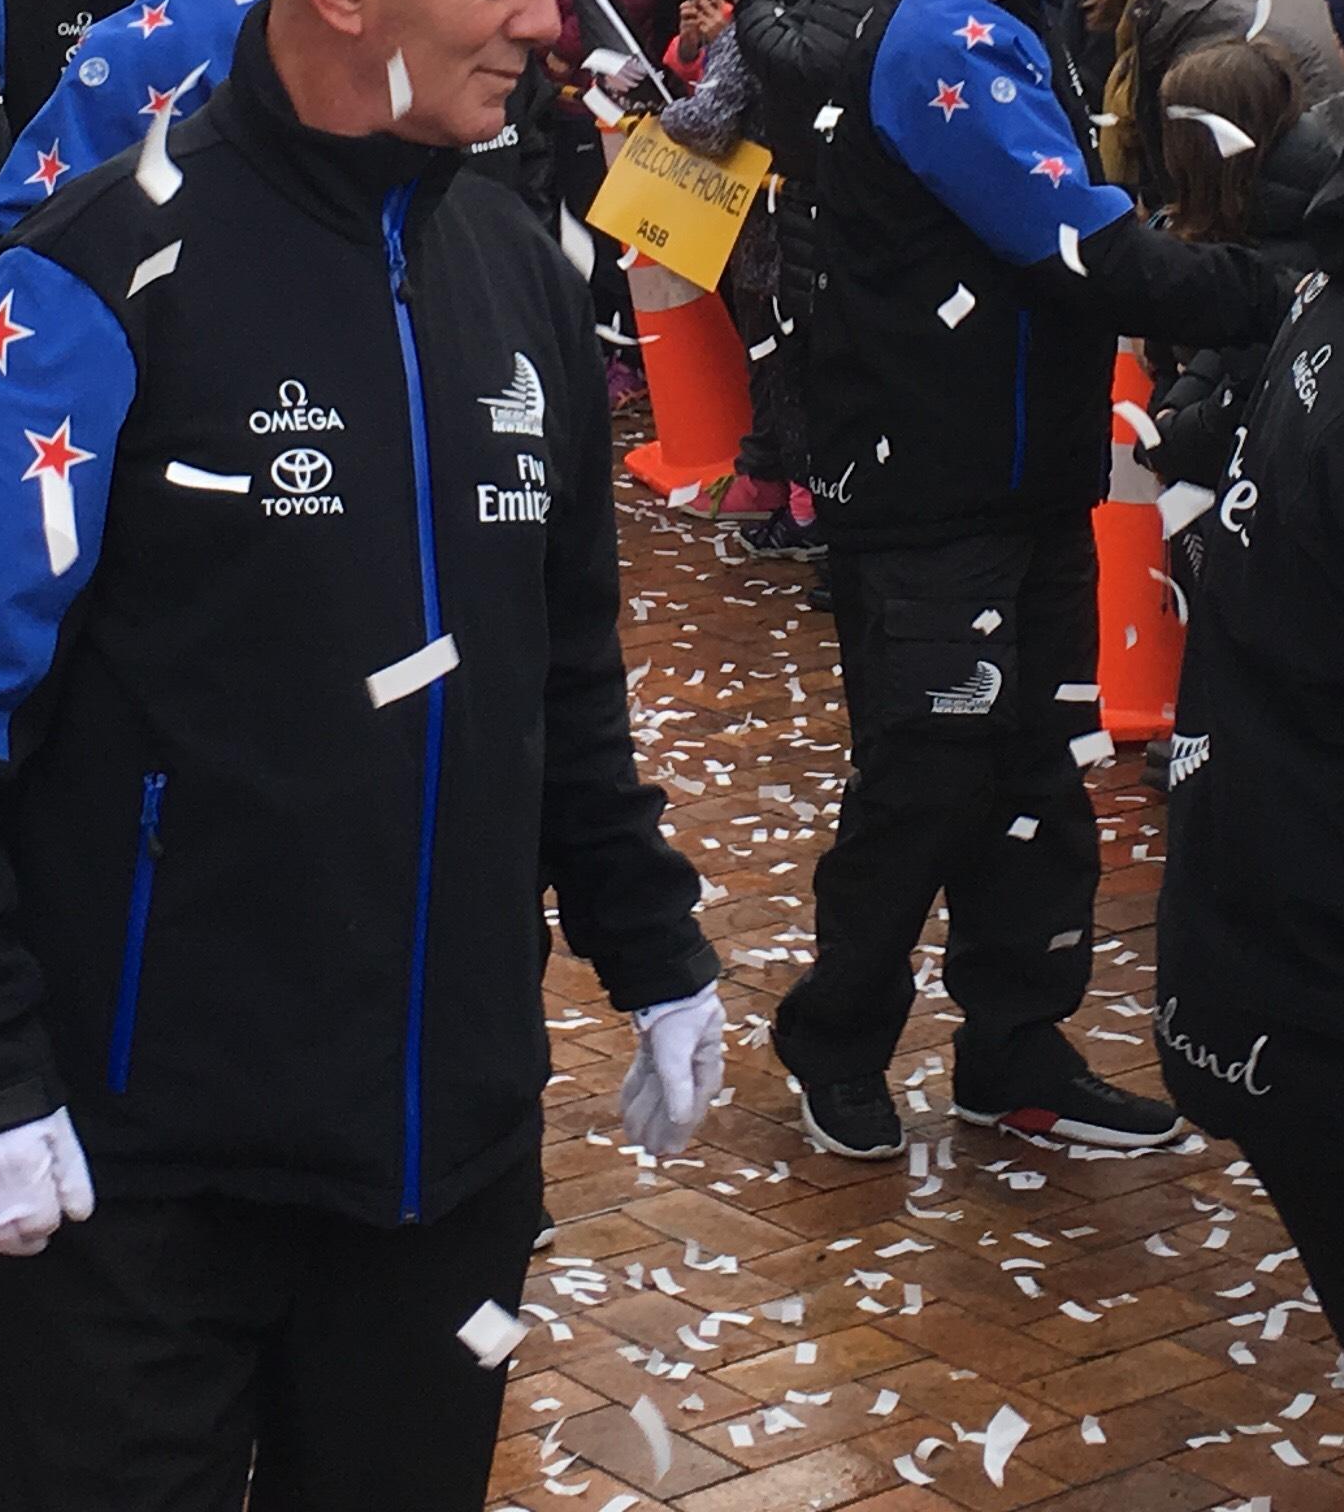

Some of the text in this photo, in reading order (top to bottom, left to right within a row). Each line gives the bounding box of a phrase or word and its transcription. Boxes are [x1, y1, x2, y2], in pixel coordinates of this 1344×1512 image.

[625, 135, 749, 217] WELCOME HOME!
[249, 408, 345, 435] OMEGA
[517, 454, 545, 486] Fly
[261, 496, 344, 517] TOYOTA
